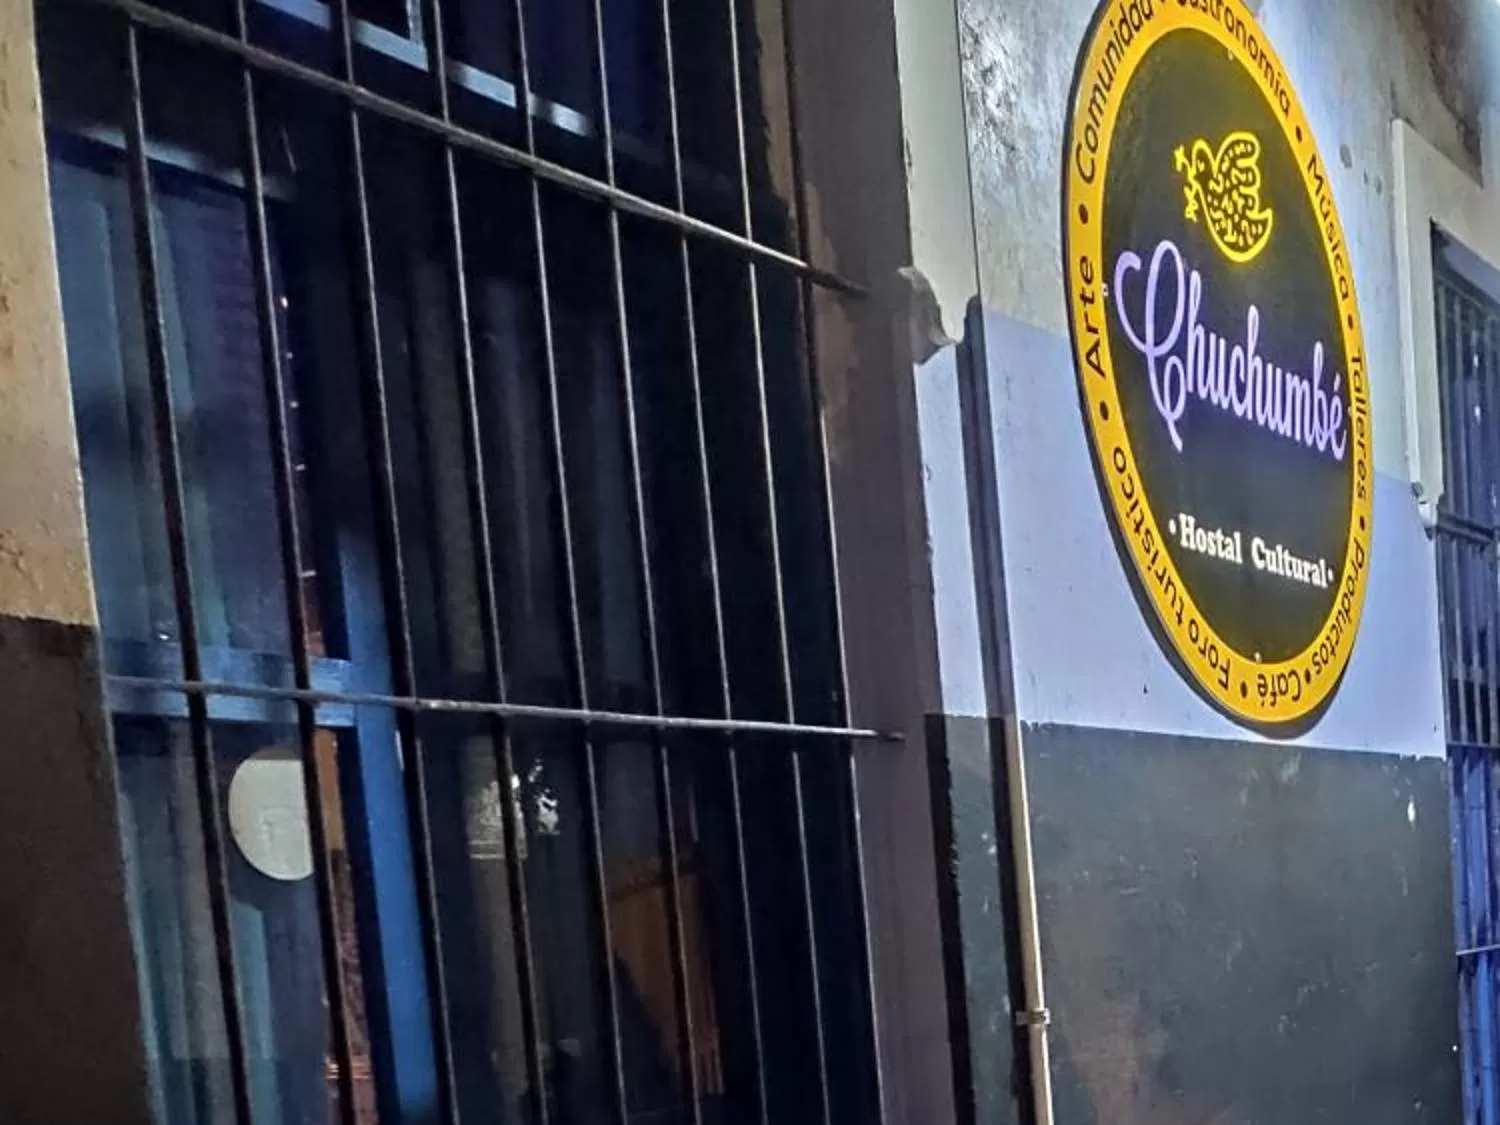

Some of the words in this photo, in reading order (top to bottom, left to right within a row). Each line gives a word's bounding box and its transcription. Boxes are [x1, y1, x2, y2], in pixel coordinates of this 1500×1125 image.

[1078, 255, 1105, 377] Arte
[1114, 239, 1346, 461] Chuchumbé
[1350, 348, 1368, 499] Talleres
[1179, 512, 1243, 565] Hostal
[1251, 536, 1328, 589] Cultural
[1188, 620, 1232, 691] Foro
[1257, 670, 1301, 708] Café
